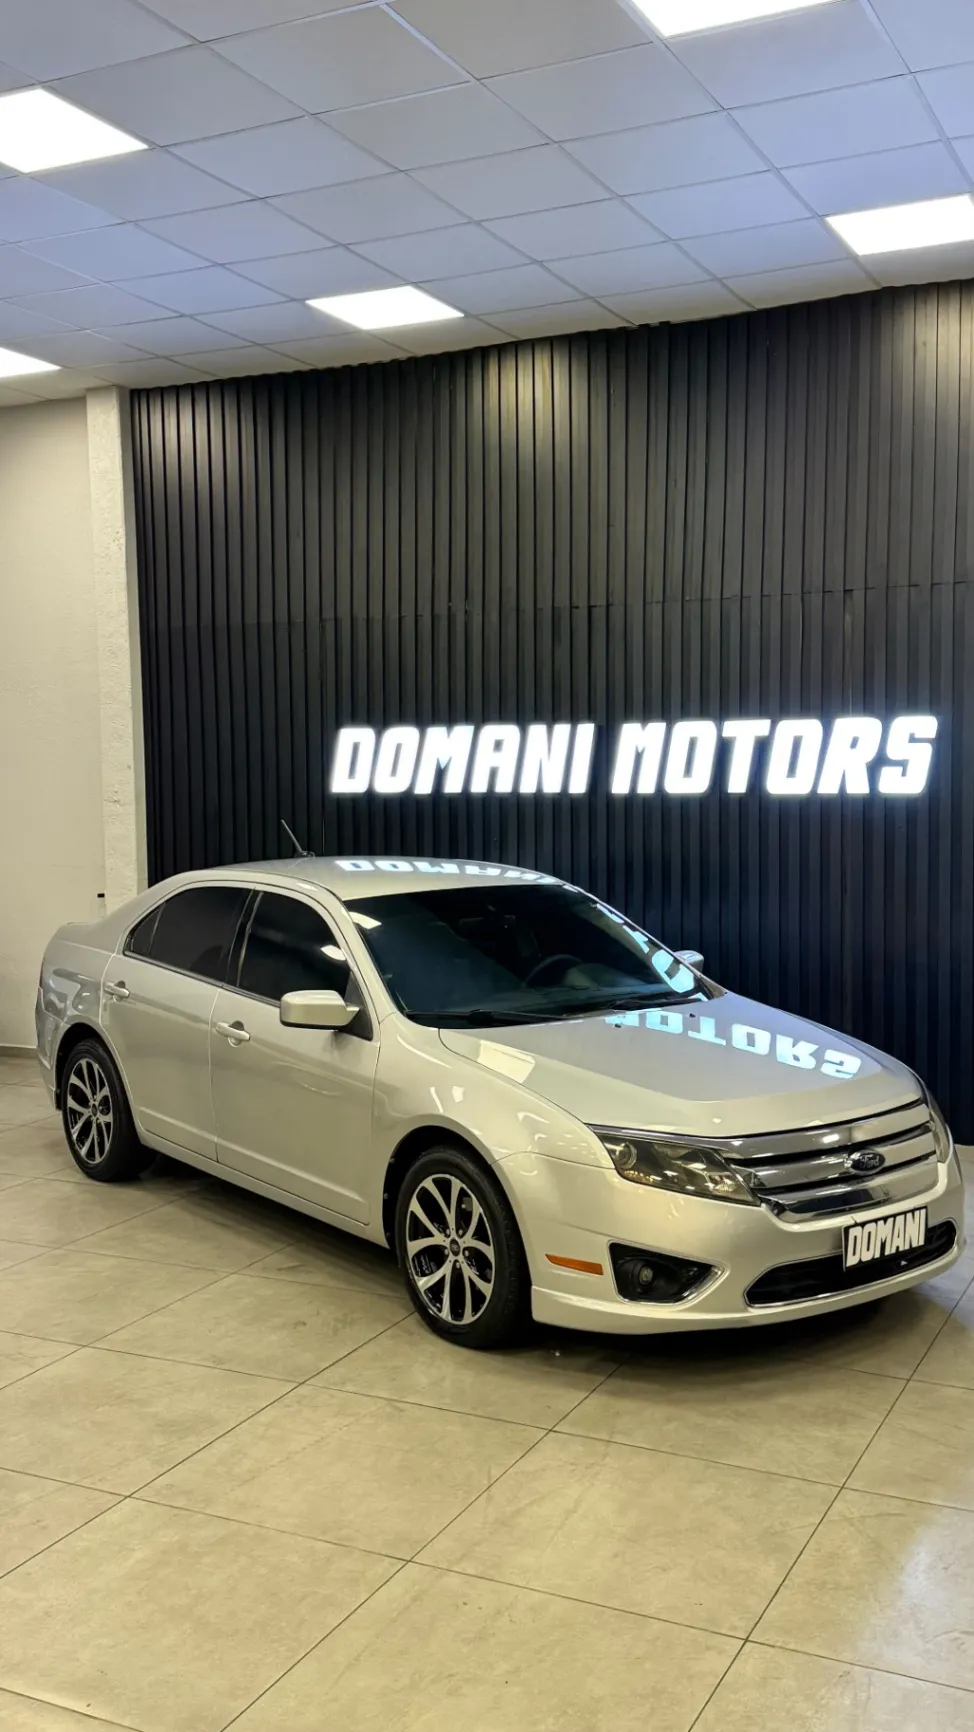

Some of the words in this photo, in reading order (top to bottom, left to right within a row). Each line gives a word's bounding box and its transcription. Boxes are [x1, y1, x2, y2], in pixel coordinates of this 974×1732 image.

[330, 723, 595, 795] DOMANI
[611, 715, 939, 796] MOTORS
[846, 1208, 927, 1268] DOMANI
